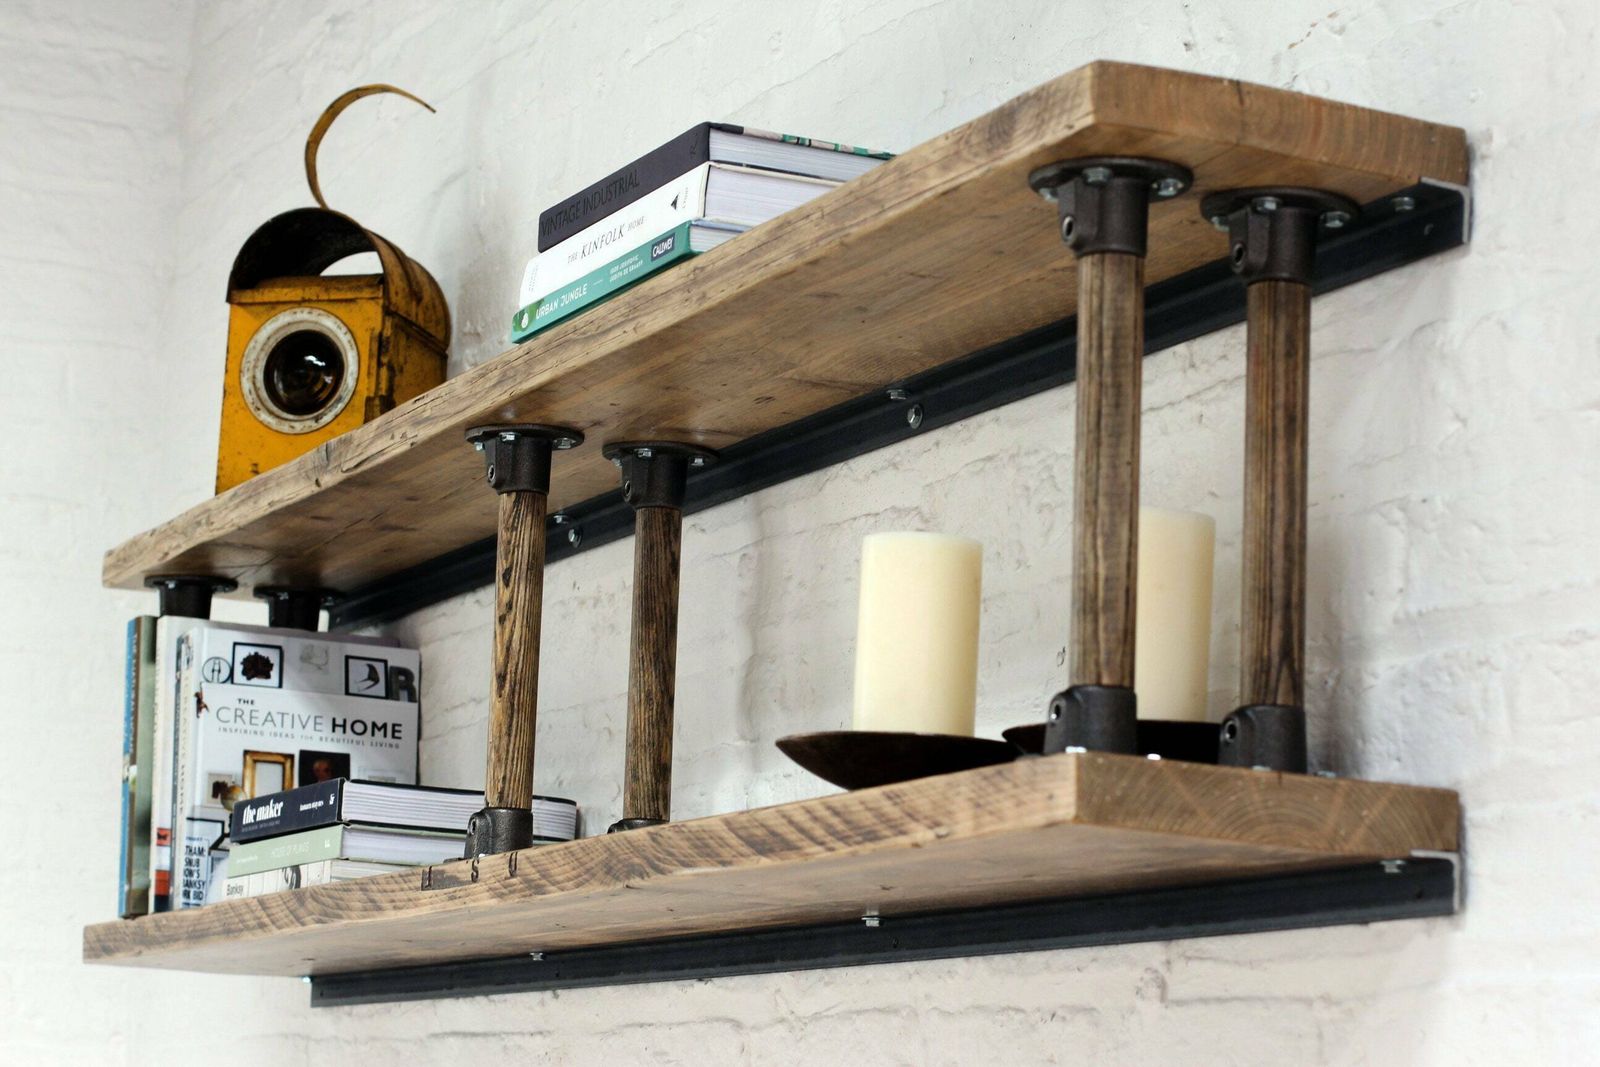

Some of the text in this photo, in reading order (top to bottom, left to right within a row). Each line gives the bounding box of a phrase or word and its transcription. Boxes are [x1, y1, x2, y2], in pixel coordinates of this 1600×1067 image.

[541, 200, 581, 237] VINTAGE
[582, 170, 641, 217] INDUSTRIAL
[580, 224, 625, 260] KINFOLK
[536, 283, 588, 320] URBAN JUNGLE
[216, 706, 402, 740] CREATIVE HOME
[218, 727, 265, 736] INSPIRING
[269, 731, 296, 739] IDEAS
[319, 736, 365, 746] BEAUTIFUL
[370, 741, 400, 749] LIVING
[243, 798, 284, 825] the maker
